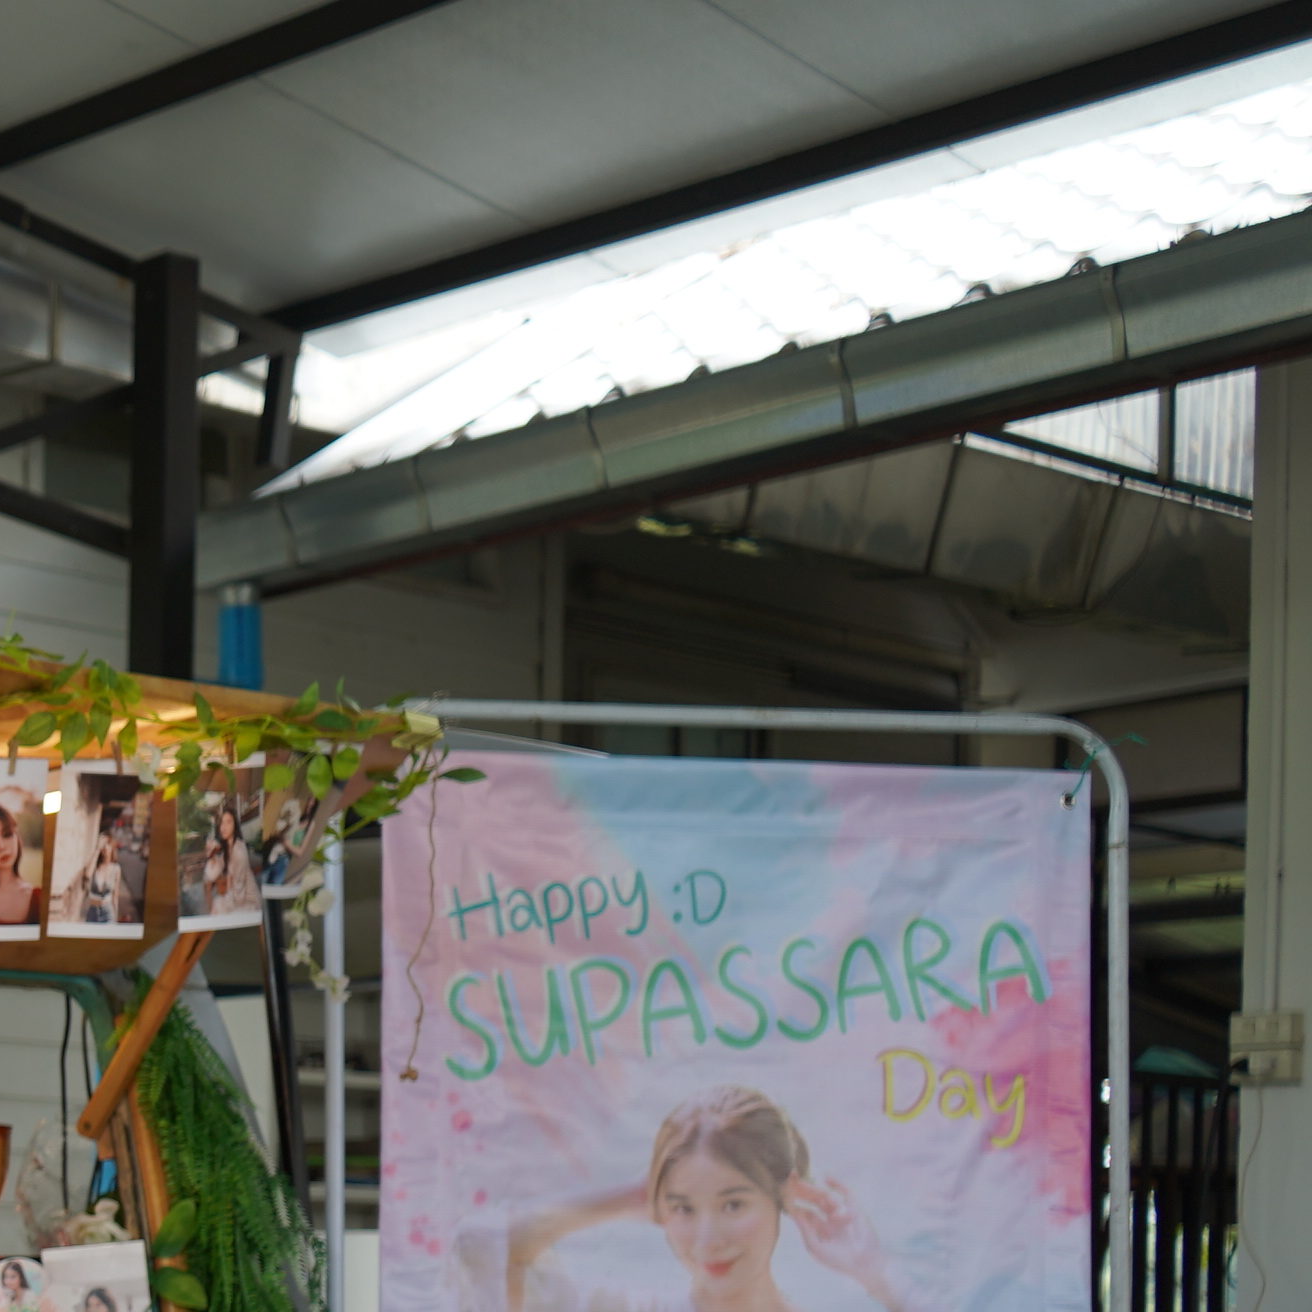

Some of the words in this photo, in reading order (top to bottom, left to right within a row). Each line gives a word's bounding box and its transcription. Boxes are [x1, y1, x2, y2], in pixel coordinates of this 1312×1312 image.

[446, 869, 649, 943] Happy
[445, 917, 1052, 1082] SUPASSARA
[876, 1048, 1028, 1148] Day
